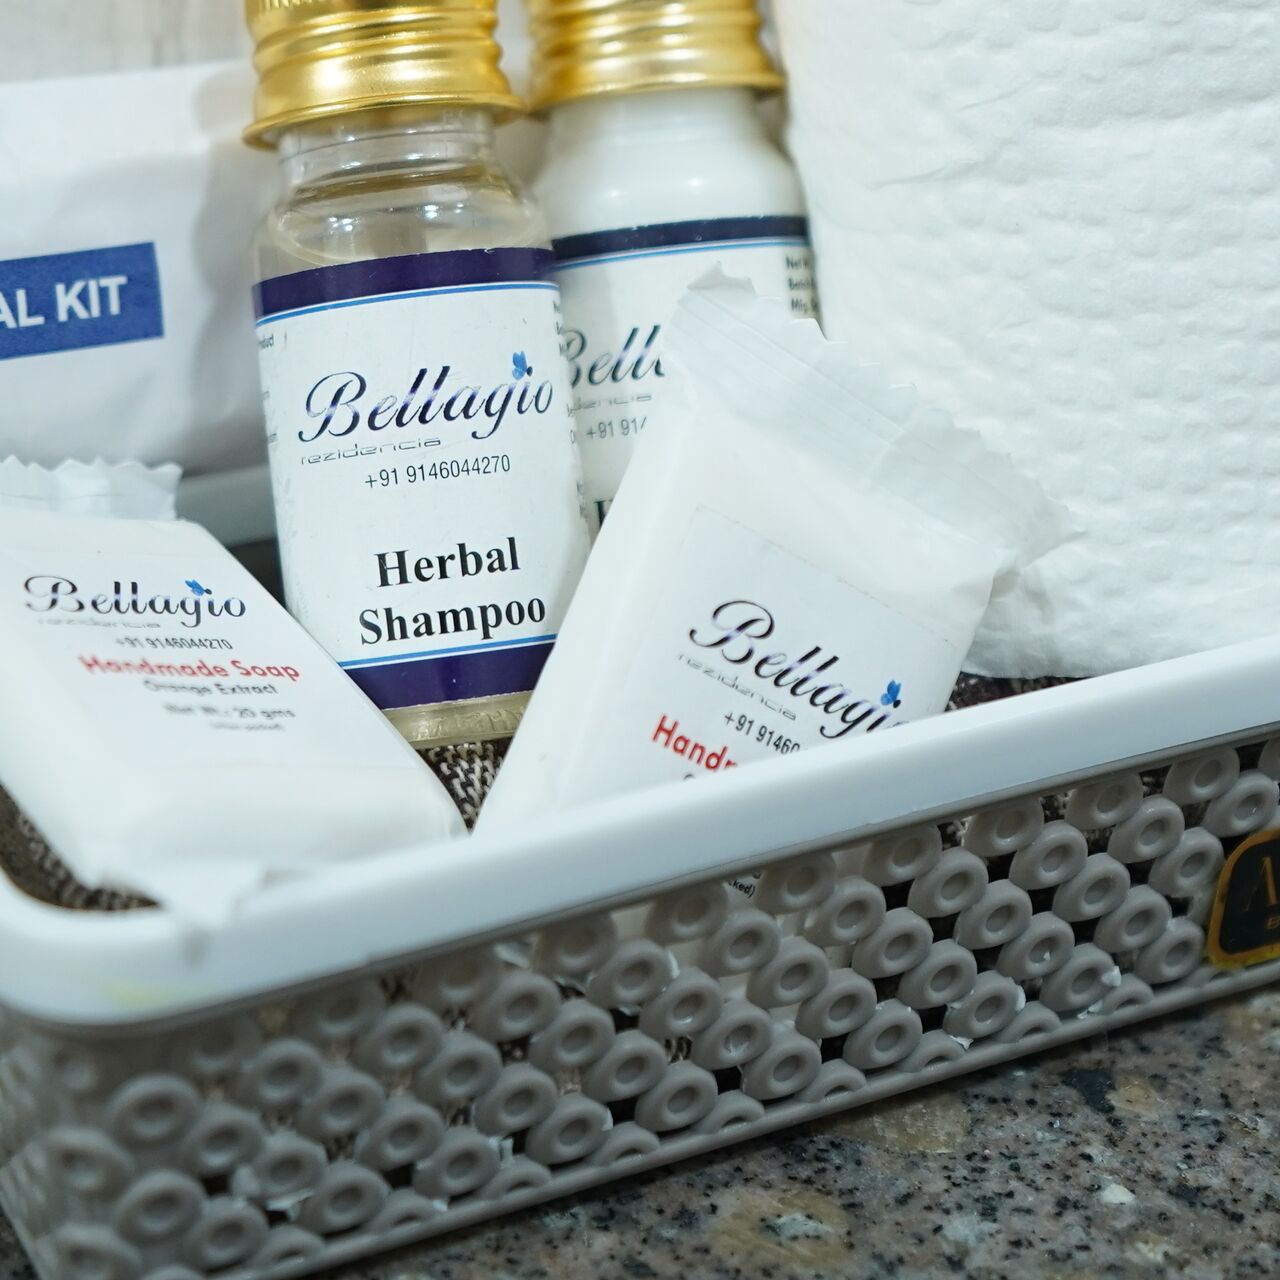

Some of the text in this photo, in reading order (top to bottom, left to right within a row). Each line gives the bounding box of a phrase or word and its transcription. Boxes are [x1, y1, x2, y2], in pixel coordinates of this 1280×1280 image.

[56, 275, 127, 323] KIT
[298, 365, 553, 442] Bellagio
[586, 420, 614, 439] +91
[301, 437, 441, 464] rezidencia
[365, 454, 511, 488] +91 9146044270
[375, 537, 521, 588] Herbal
[24, 575, 246, 628] Bellagio
[359, 595, 546, 646] Shampoo
[147, 637, 233, 651] 9146044270
[78, 653, 301, 682] Handmade Soap
[678, 653, 797, 721] rezidencia
[689, 600, 909, 739] Bellagi
[215, 682, 279, 696] Extract
[724, 711, 755, 736] +91
